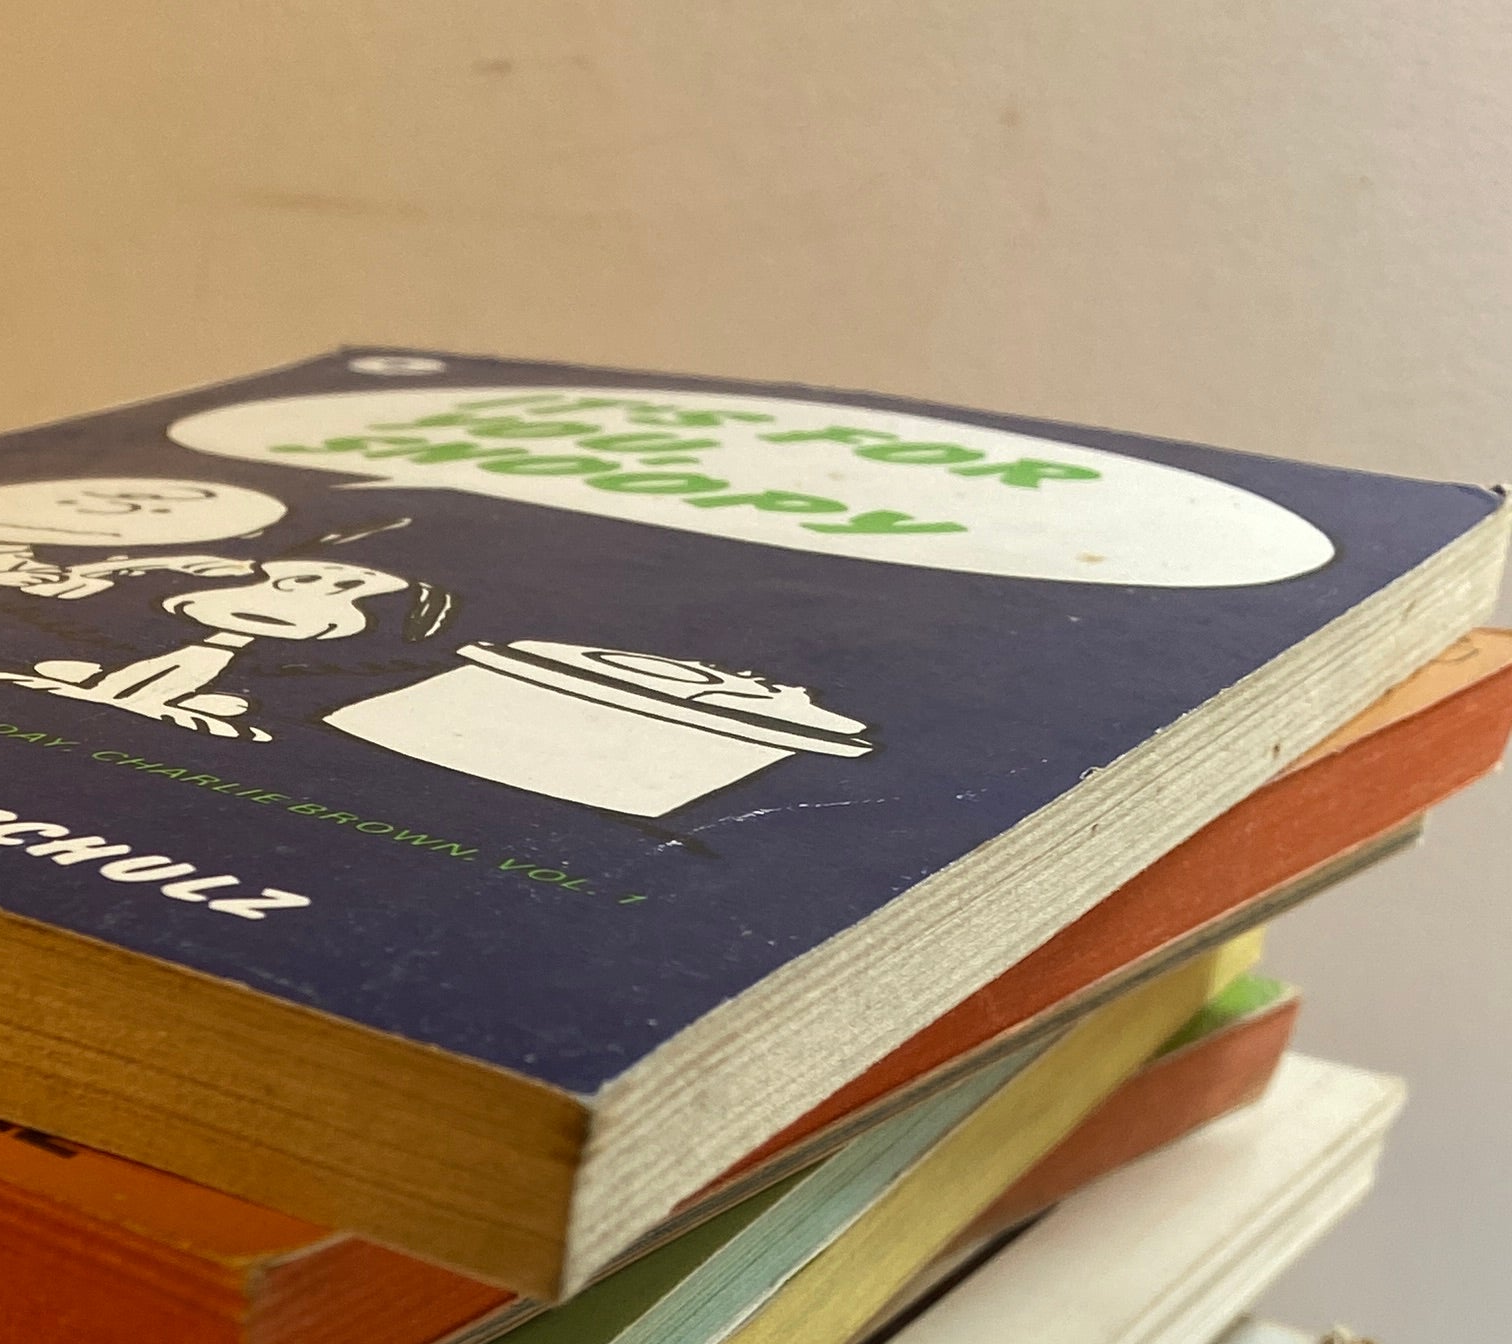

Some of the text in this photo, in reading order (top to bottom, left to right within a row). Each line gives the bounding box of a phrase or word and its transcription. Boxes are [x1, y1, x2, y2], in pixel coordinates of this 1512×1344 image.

[269, 436, 968, 534] SNOOPY
[757, 426, 1102, 489] FOR
[91, 750, 290, 804] CHARLIE
[499, 858, 595, 895] VOL.
